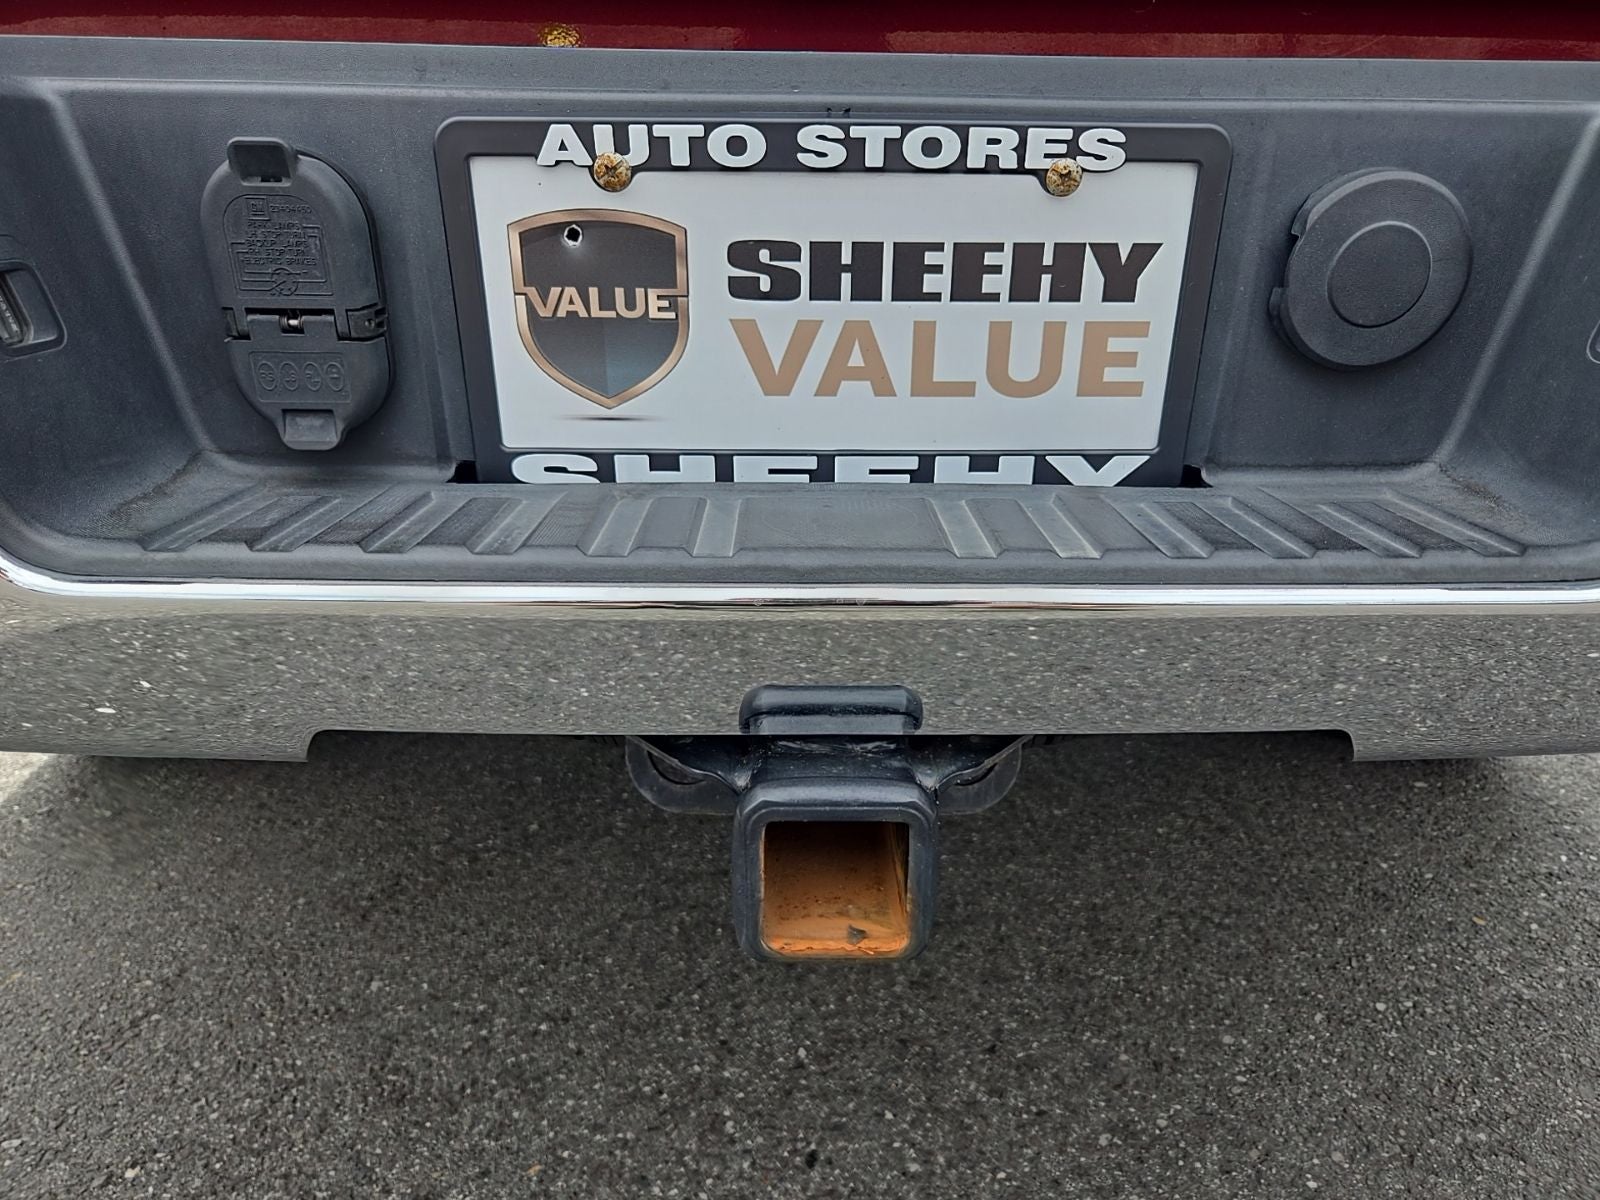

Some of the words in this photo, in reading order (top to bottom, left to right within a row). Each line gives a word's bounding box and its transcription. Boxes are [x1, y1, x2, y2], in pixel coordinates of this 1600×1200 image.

[536, 123, 767, 168] AUTO
[796, 124, 1127, 171] STORES
[727, 239, 1162, 304] SHEEHY
[524, 286, 676, 320] VALUE
[730, 318, 1150, 399] VALUE
